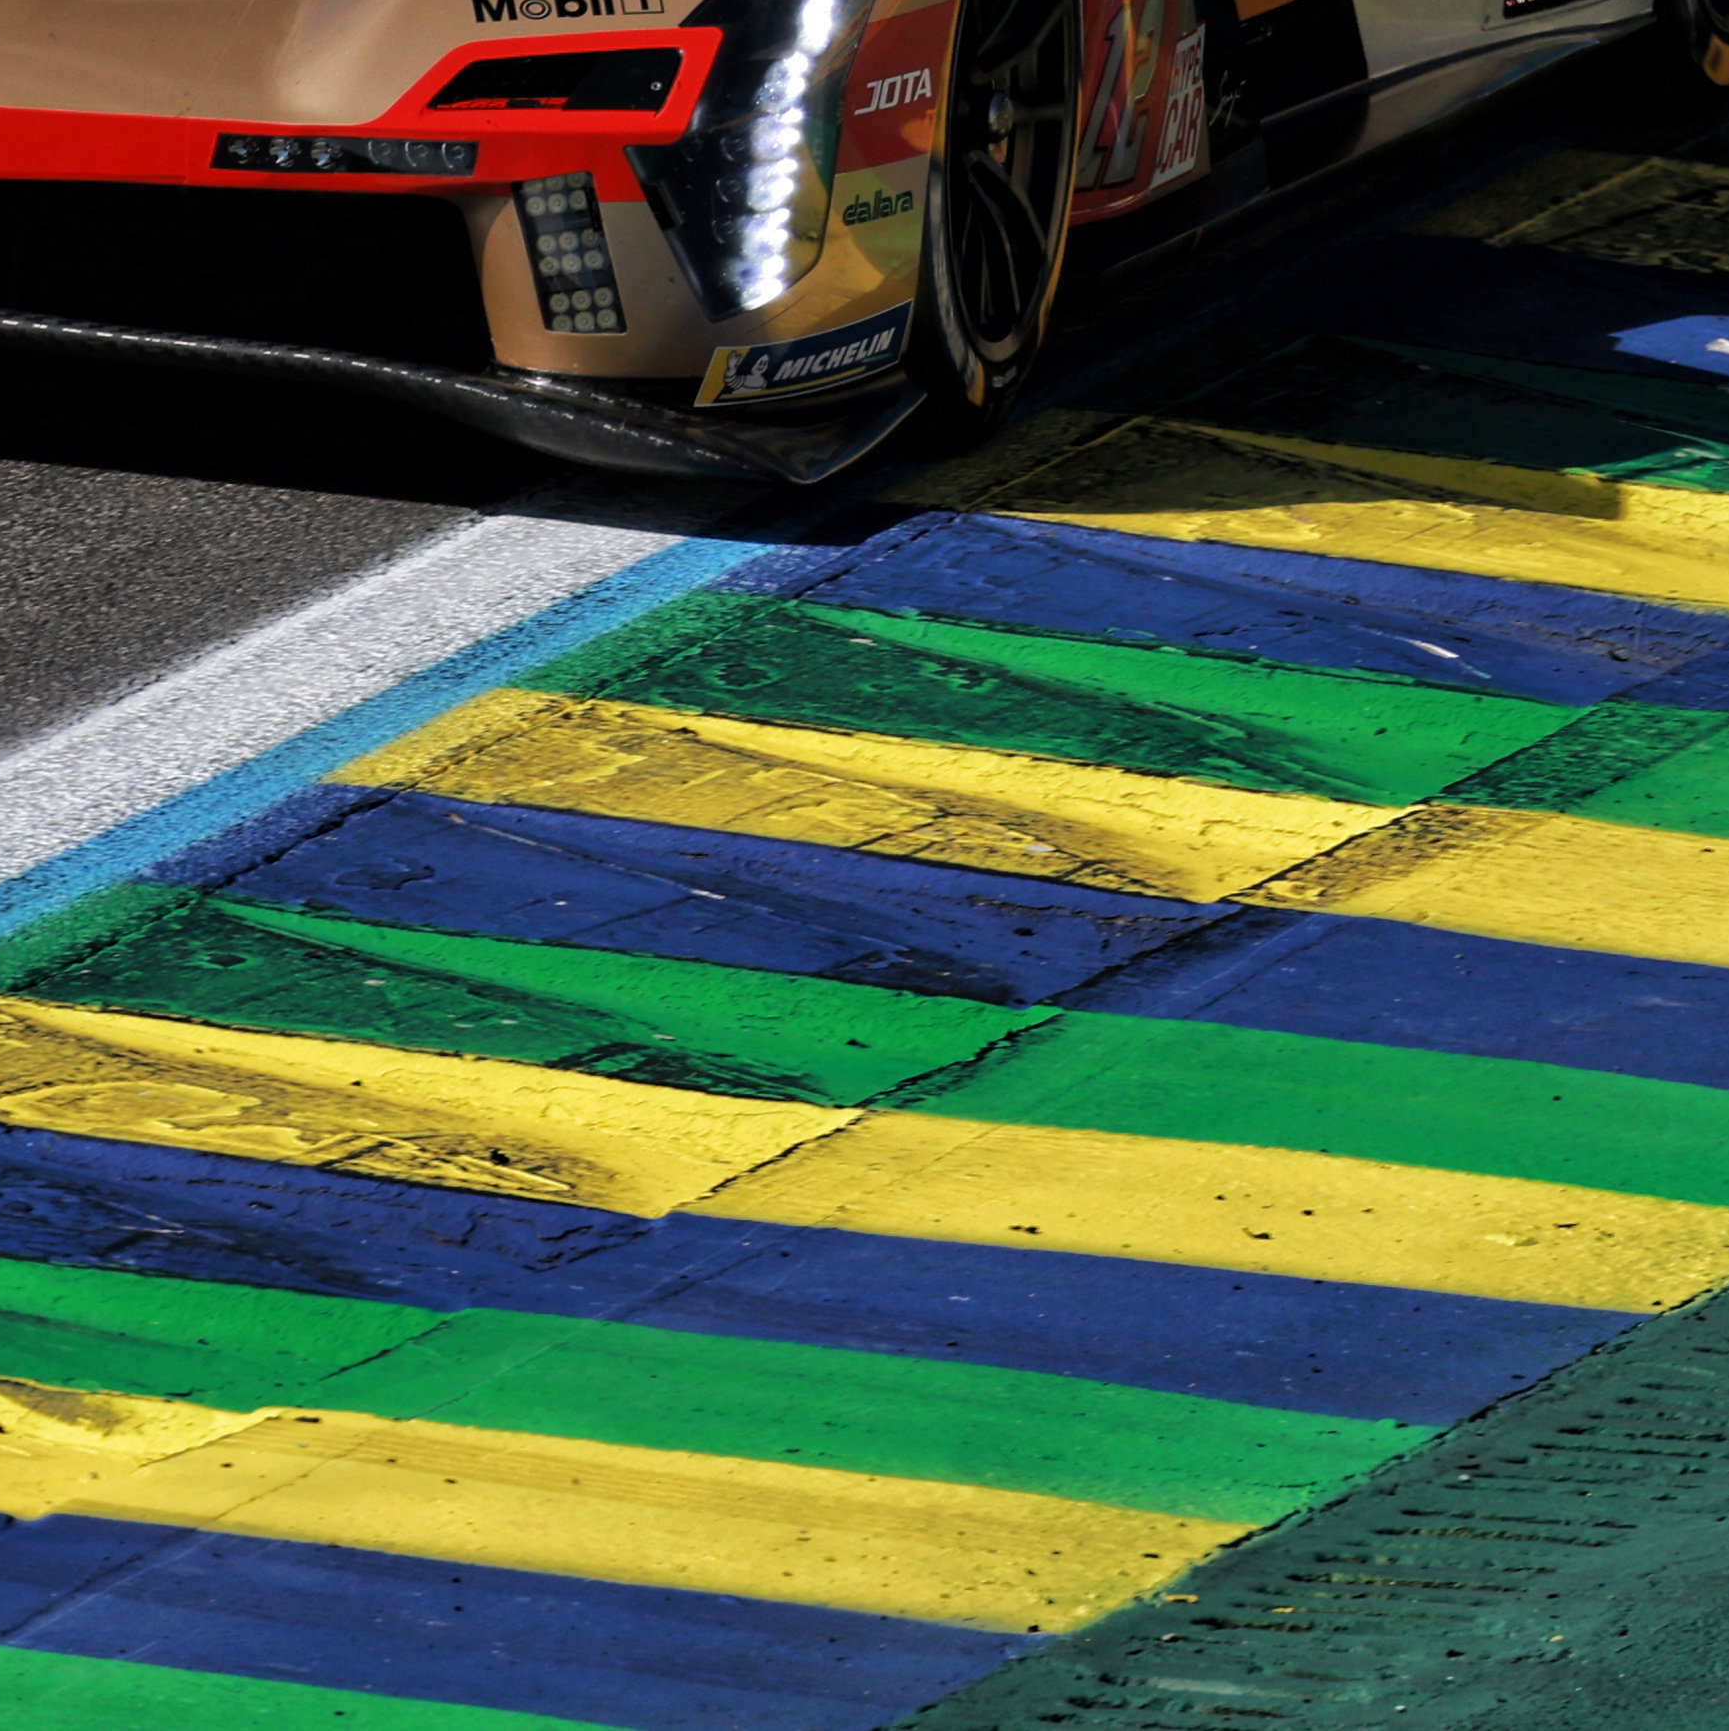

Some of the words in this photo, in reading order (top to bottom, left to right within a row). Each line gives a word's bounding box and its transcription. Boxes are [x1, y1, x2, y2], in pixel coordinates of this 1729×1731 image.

[853, 69, 933, 116] JOTA
[1157, 85, 1202, 174] CAR
[842, 190, 913, 225] dallara
[773, 327, 896, 382] MICHELIN
